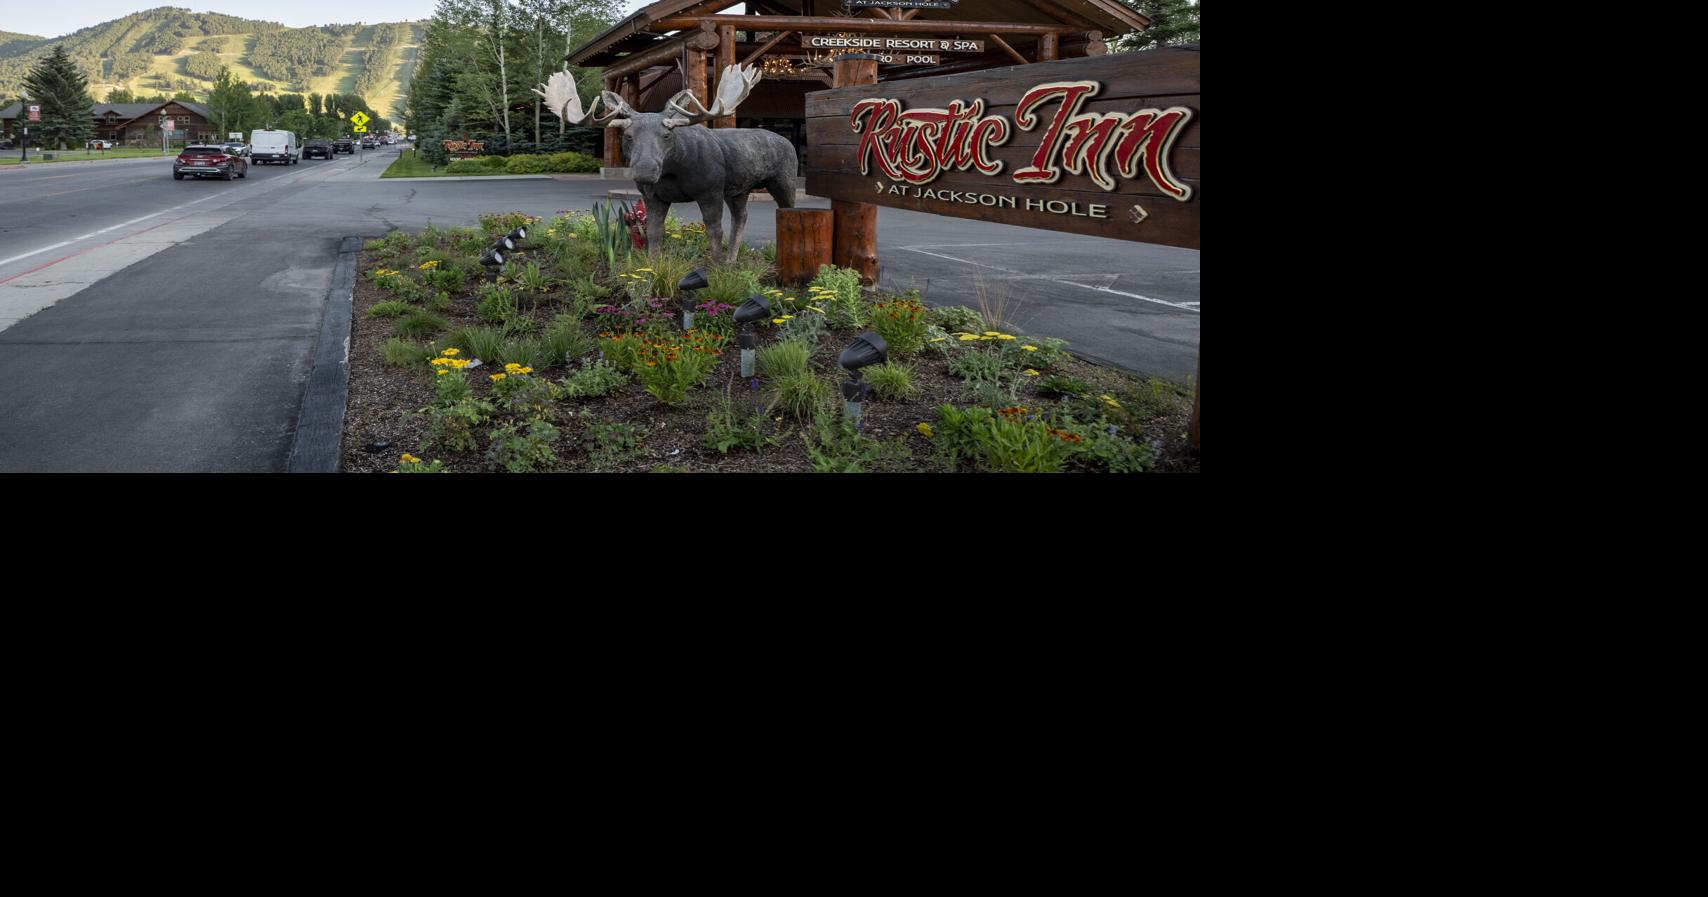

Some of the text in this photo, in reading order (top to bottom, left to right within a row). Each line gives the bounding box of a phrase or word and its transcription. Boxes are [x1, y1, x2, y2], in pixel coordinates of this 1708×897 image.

[811, 37, 978, 50] CREEKSIDE RESORT & SPA
[907, 55, 936, 64] POOL
[848, 80, 1193, 203] Rustic Inn
[888, 184, 1109, 220] AT JACKSON HOLE
